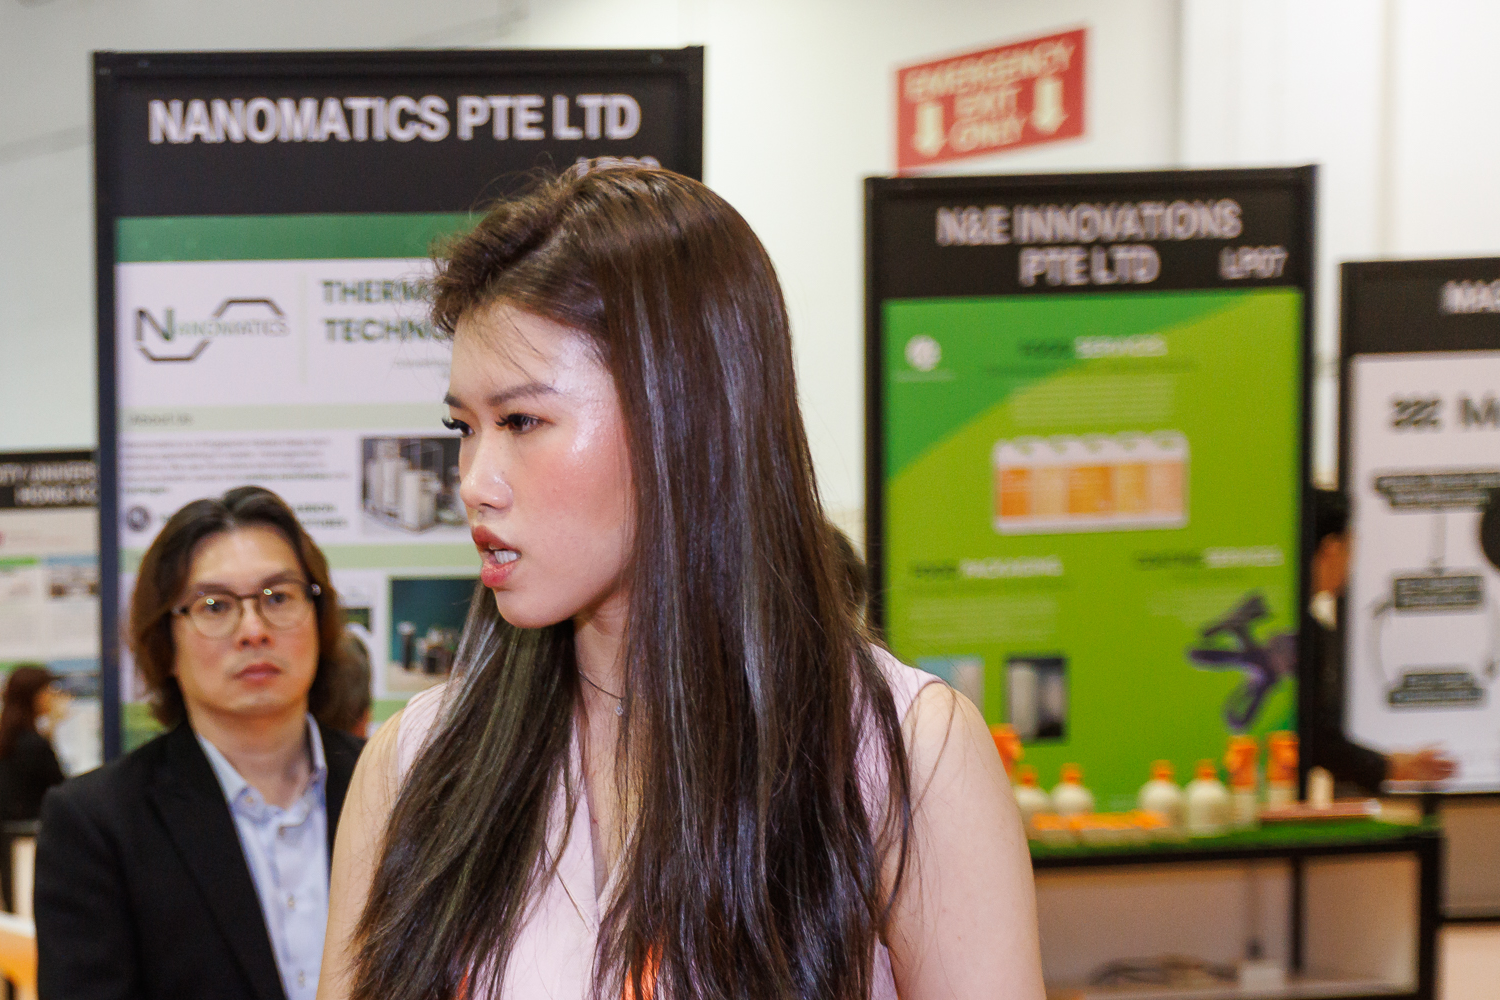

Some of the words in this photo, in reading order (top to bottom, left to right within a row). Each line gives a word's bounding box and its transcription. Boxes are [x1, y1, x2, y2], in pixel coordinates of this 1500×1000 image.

[148, 95, 450, 145] NANOMATICS
[457, 94, 546, 142] PTE
[552, 93, 643, 142] LTD
[935, 205, 1011, 247] N&E
[1013, 199, 1243, 244] INNOVATIONS
[1018, 246, 1091, 287] PTE
[1092, 244, 1162, 285] LTD
